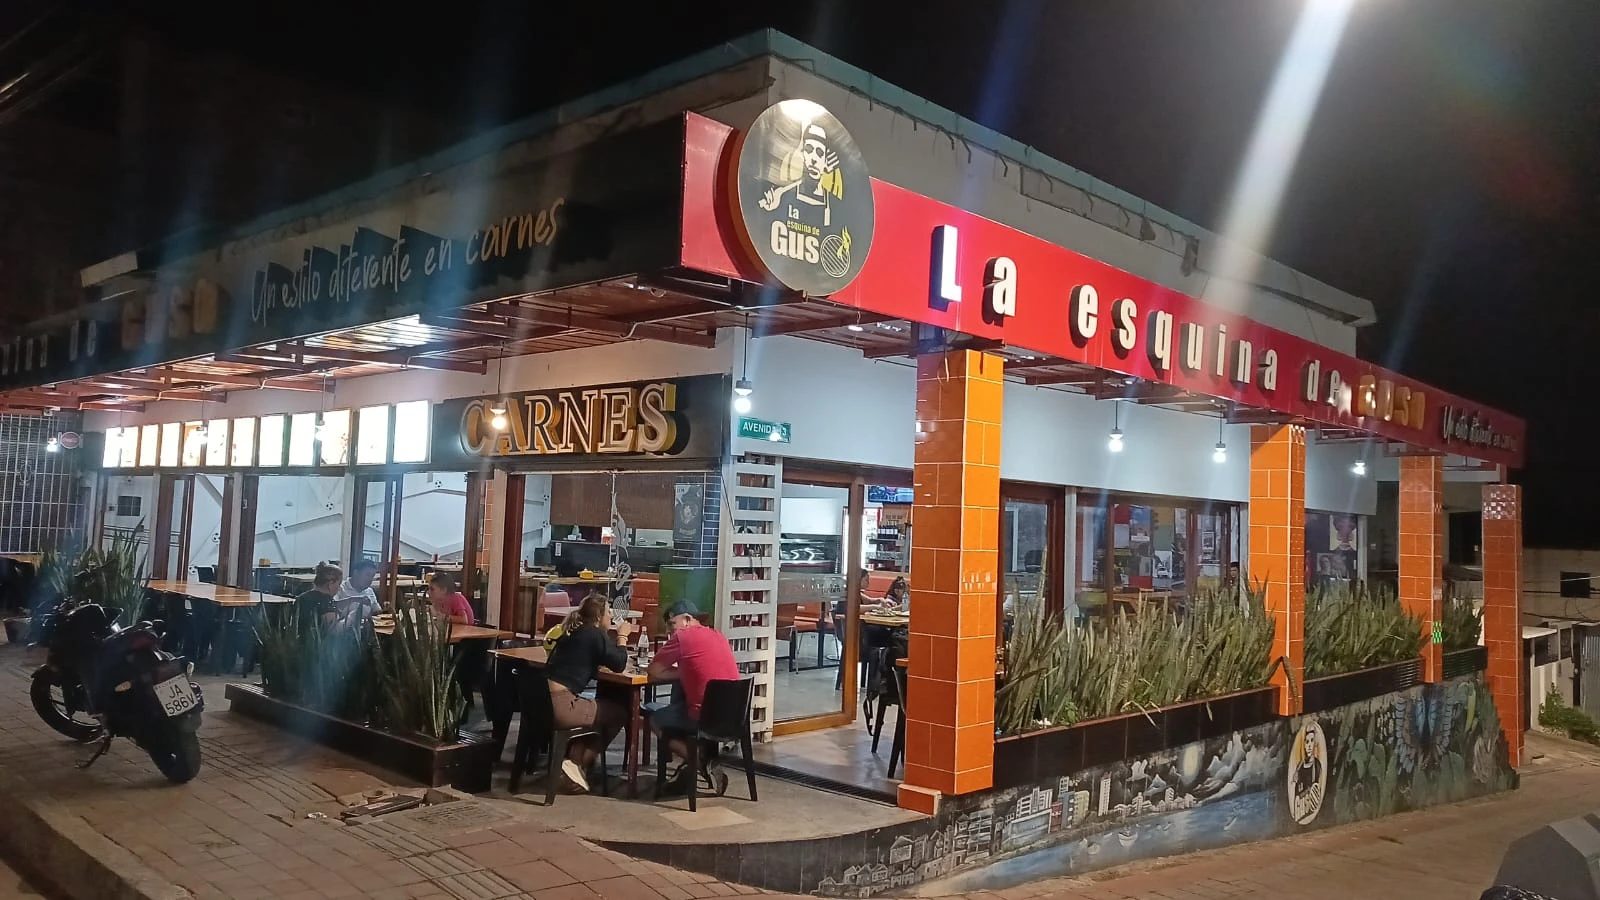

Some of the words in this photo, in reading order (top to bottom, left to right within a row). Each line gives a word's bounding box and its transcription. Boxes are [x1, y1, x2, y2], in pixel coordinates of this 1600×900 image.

[787, 220, 811, 233] esquina
[788, 204, 799, 219] La
[424, 238, 452, 276] en
[466, 197, 565, 265] carnes
[938, 223, 1017, 318] La
[1076, 284, 1278, 391] esquina
[1306, 360, 1341, 408] de
[459, 383, 677, 456] CARNES
[169, 684, 183, 699] JA
